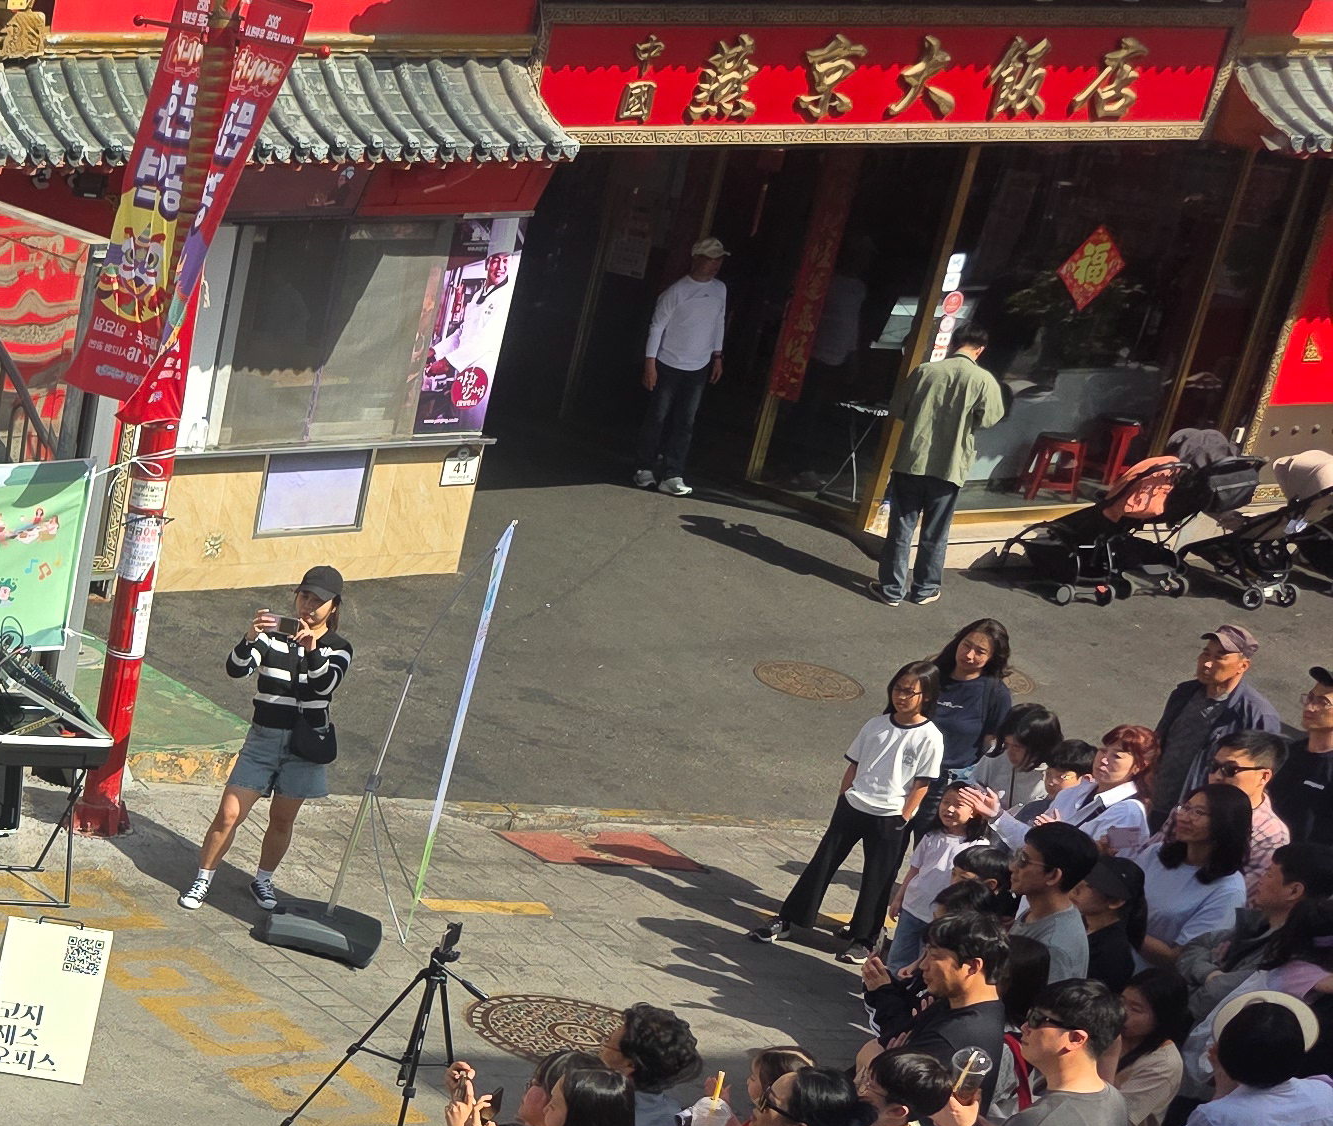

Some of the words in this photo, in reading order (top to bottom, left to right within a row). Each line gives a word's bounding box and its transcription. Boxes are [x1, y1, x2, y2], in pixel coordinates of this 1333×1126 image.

[621, 35, 666, 122] 中國
[689, 33, 1150, 121] 燕京大飯店
[1071, 242, 1111, 287] 福
[453, 462, 468, 474] 41
